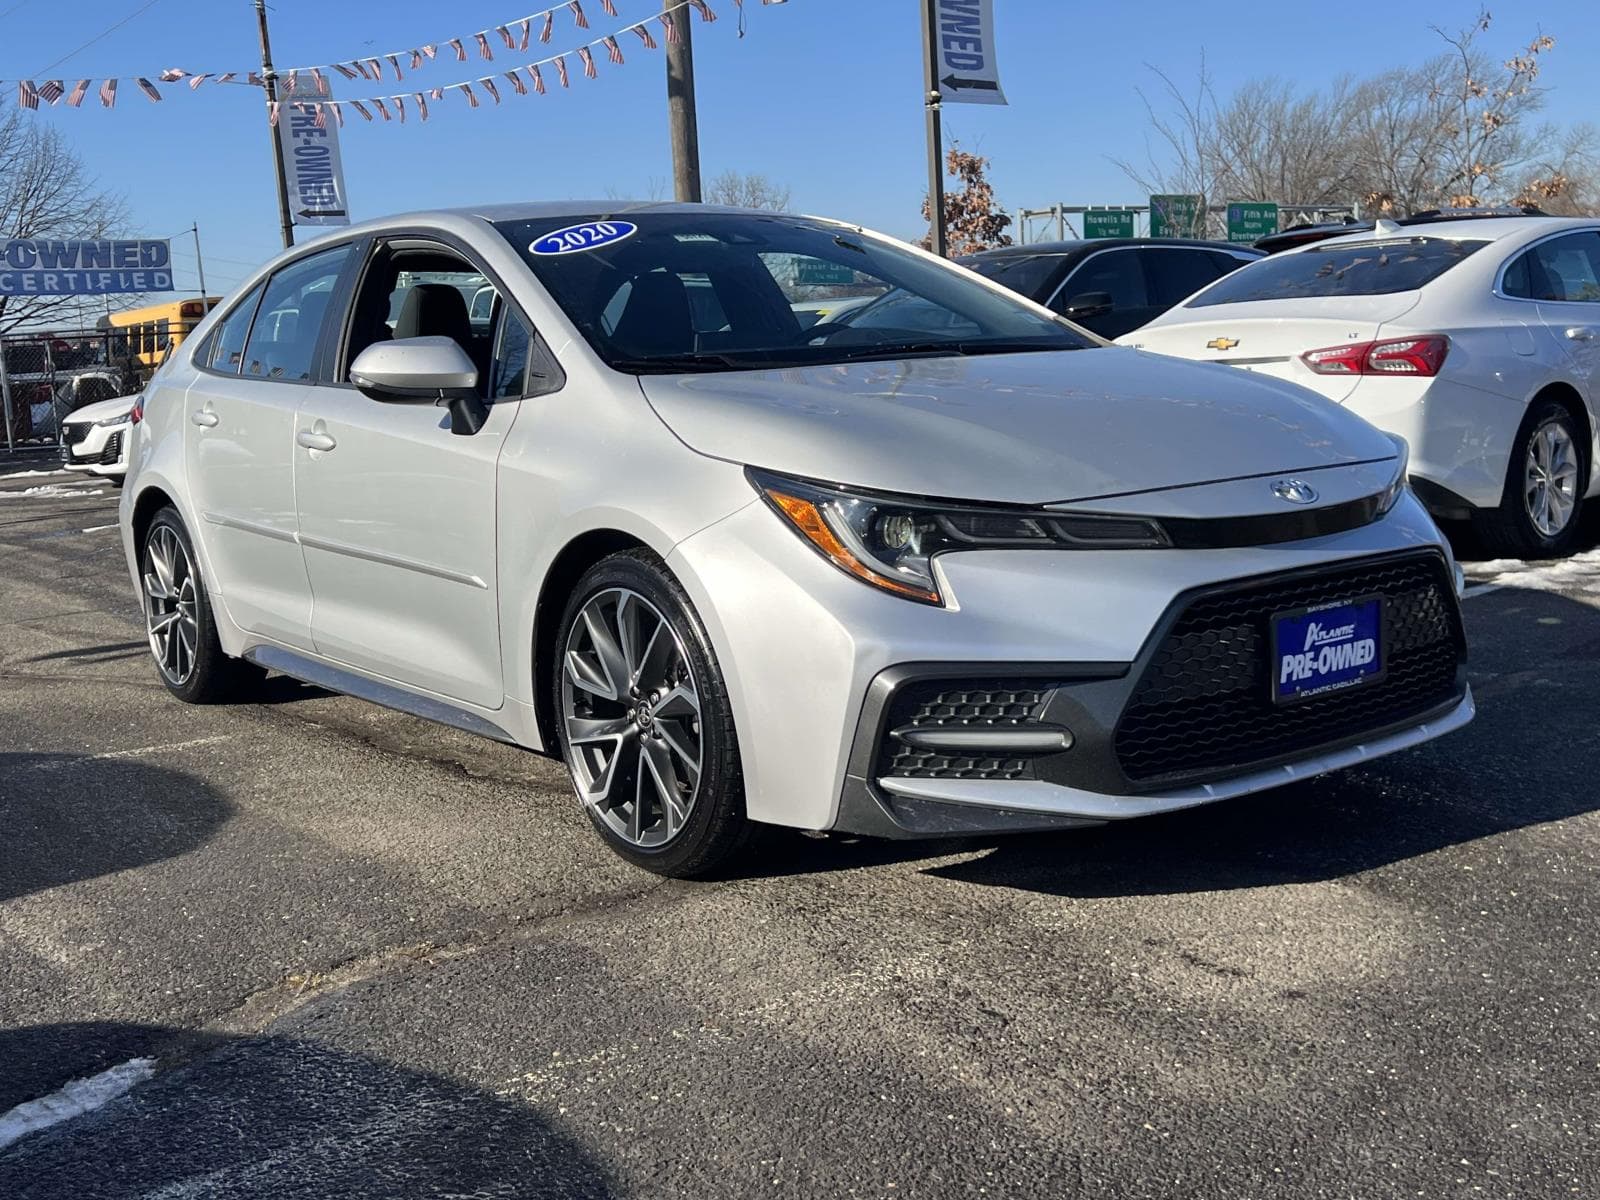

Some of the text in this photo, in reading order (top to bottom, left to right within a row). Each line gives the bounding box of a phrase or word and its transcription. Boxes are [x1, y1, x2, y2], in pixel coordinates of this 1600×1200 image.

[1087, 215, 1131, 224] Howells Rd
[1243, 210, 1276, 219] Fifth Ave
[547, 222, 618, 253] 2020
[0, 272, 171, 292] CERTIFIED
[1303, 622, 1355, 651] ATLANTIC
[1280, 638, 1376, 684] PRE-OWNED
[1300, 677, 1363, 697] ATLANTIC CADILLAC
